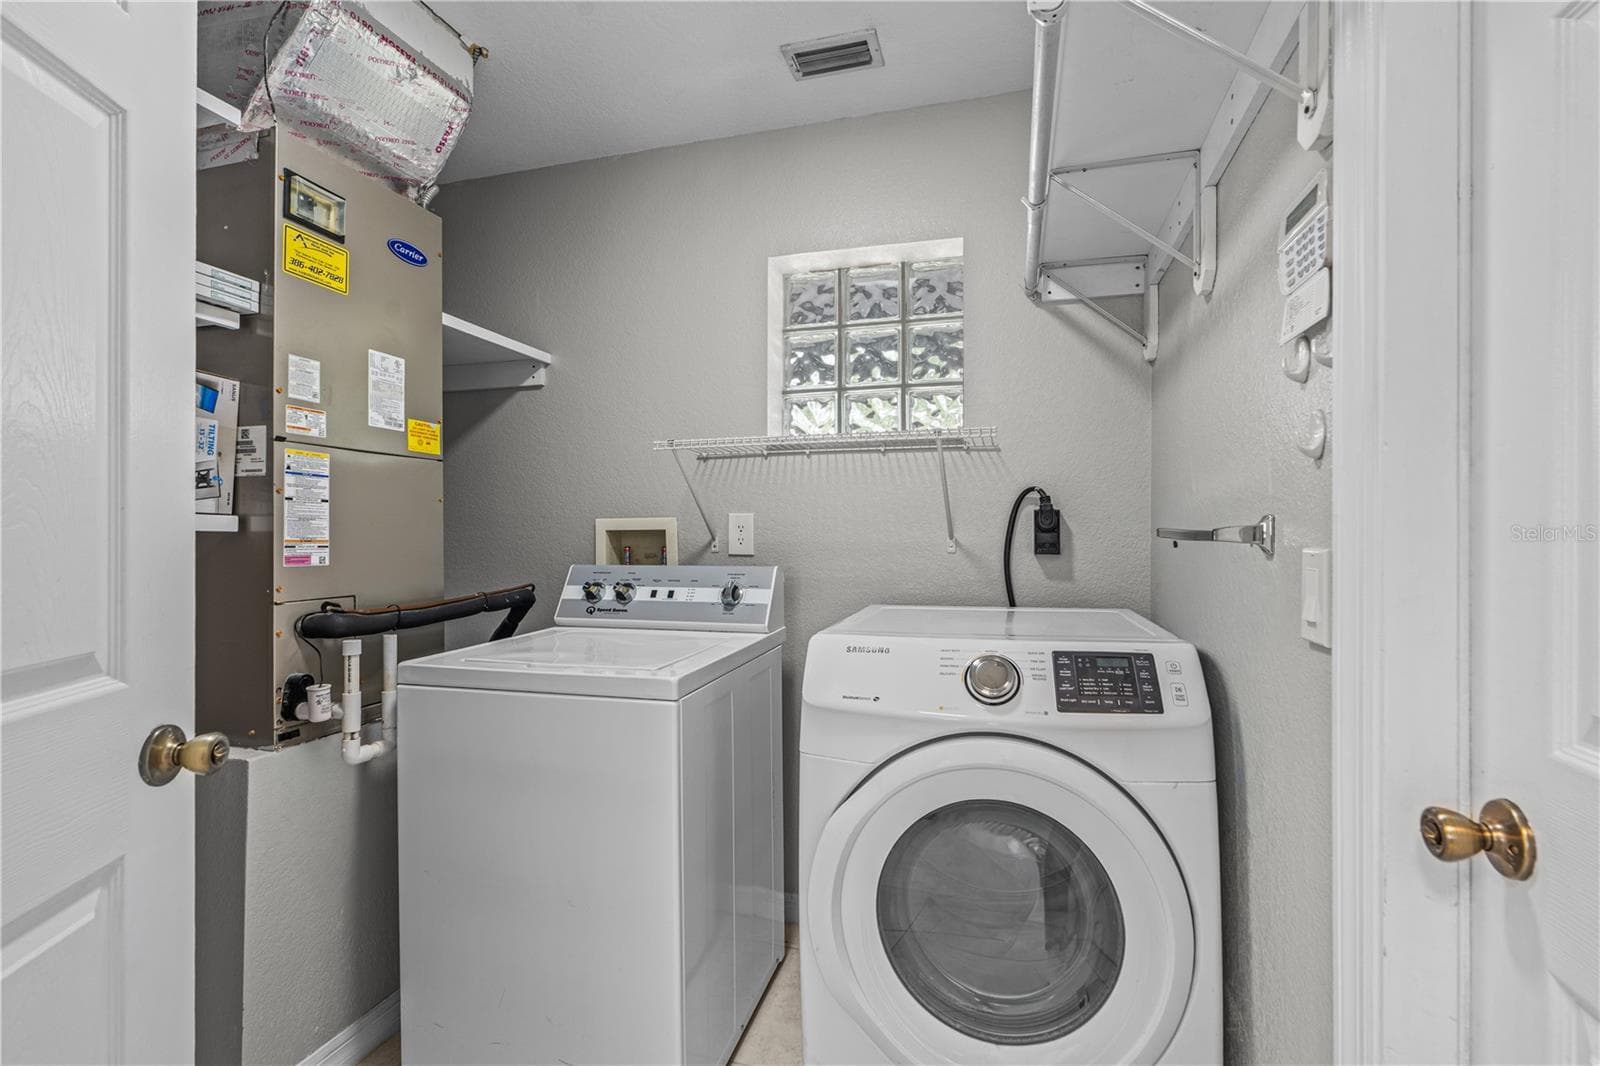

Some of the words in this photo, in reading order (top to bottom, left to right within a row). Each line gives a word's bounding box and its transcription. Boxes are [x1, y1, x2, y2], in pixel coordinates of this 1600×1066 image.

[393, 243, 424, 262] Carrier
[206, 423, 216, 457] TILTING
[845, 645, 891, 655] SAMSUNG
